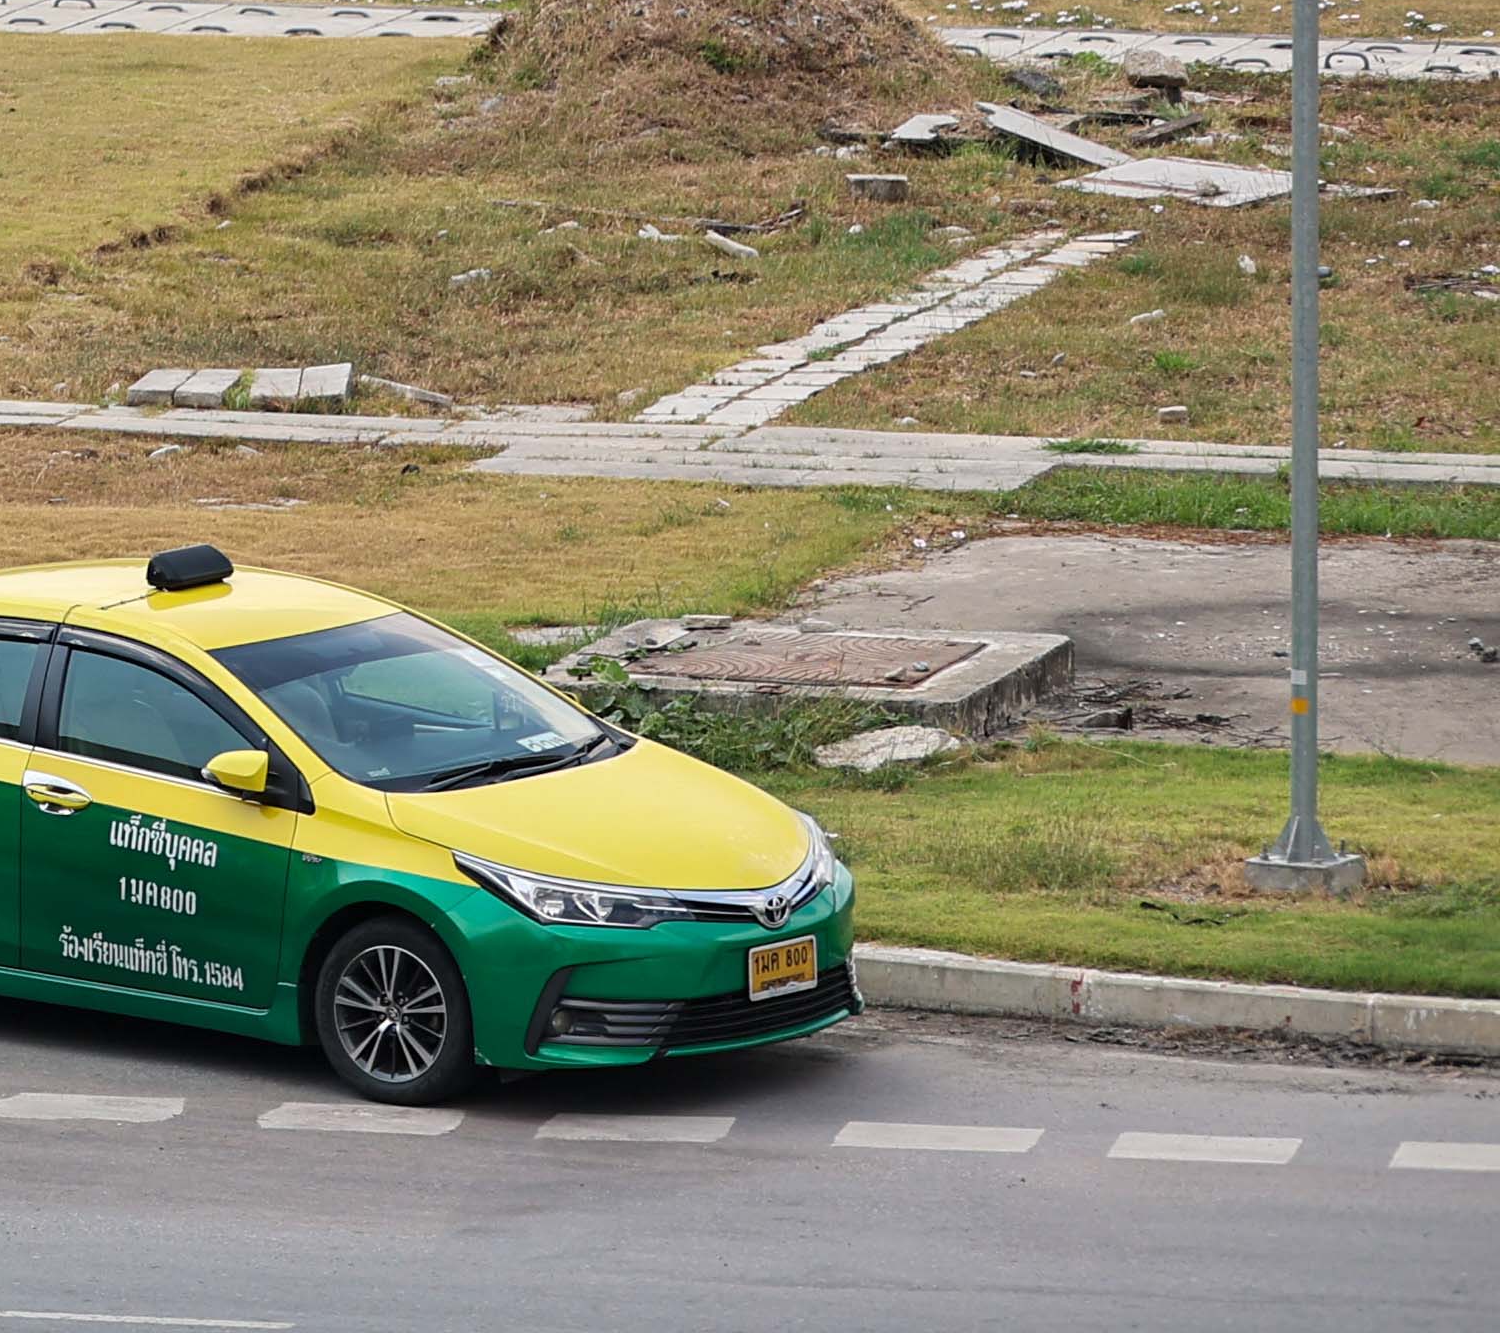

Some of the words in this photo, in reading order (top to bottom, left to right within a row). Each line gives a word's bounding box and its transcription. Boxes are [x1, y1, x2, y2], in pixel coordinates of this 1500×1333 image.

[109, 815, 218, 870] แท็กซี่บุคคล
[786, 944, 809, 968] 800
